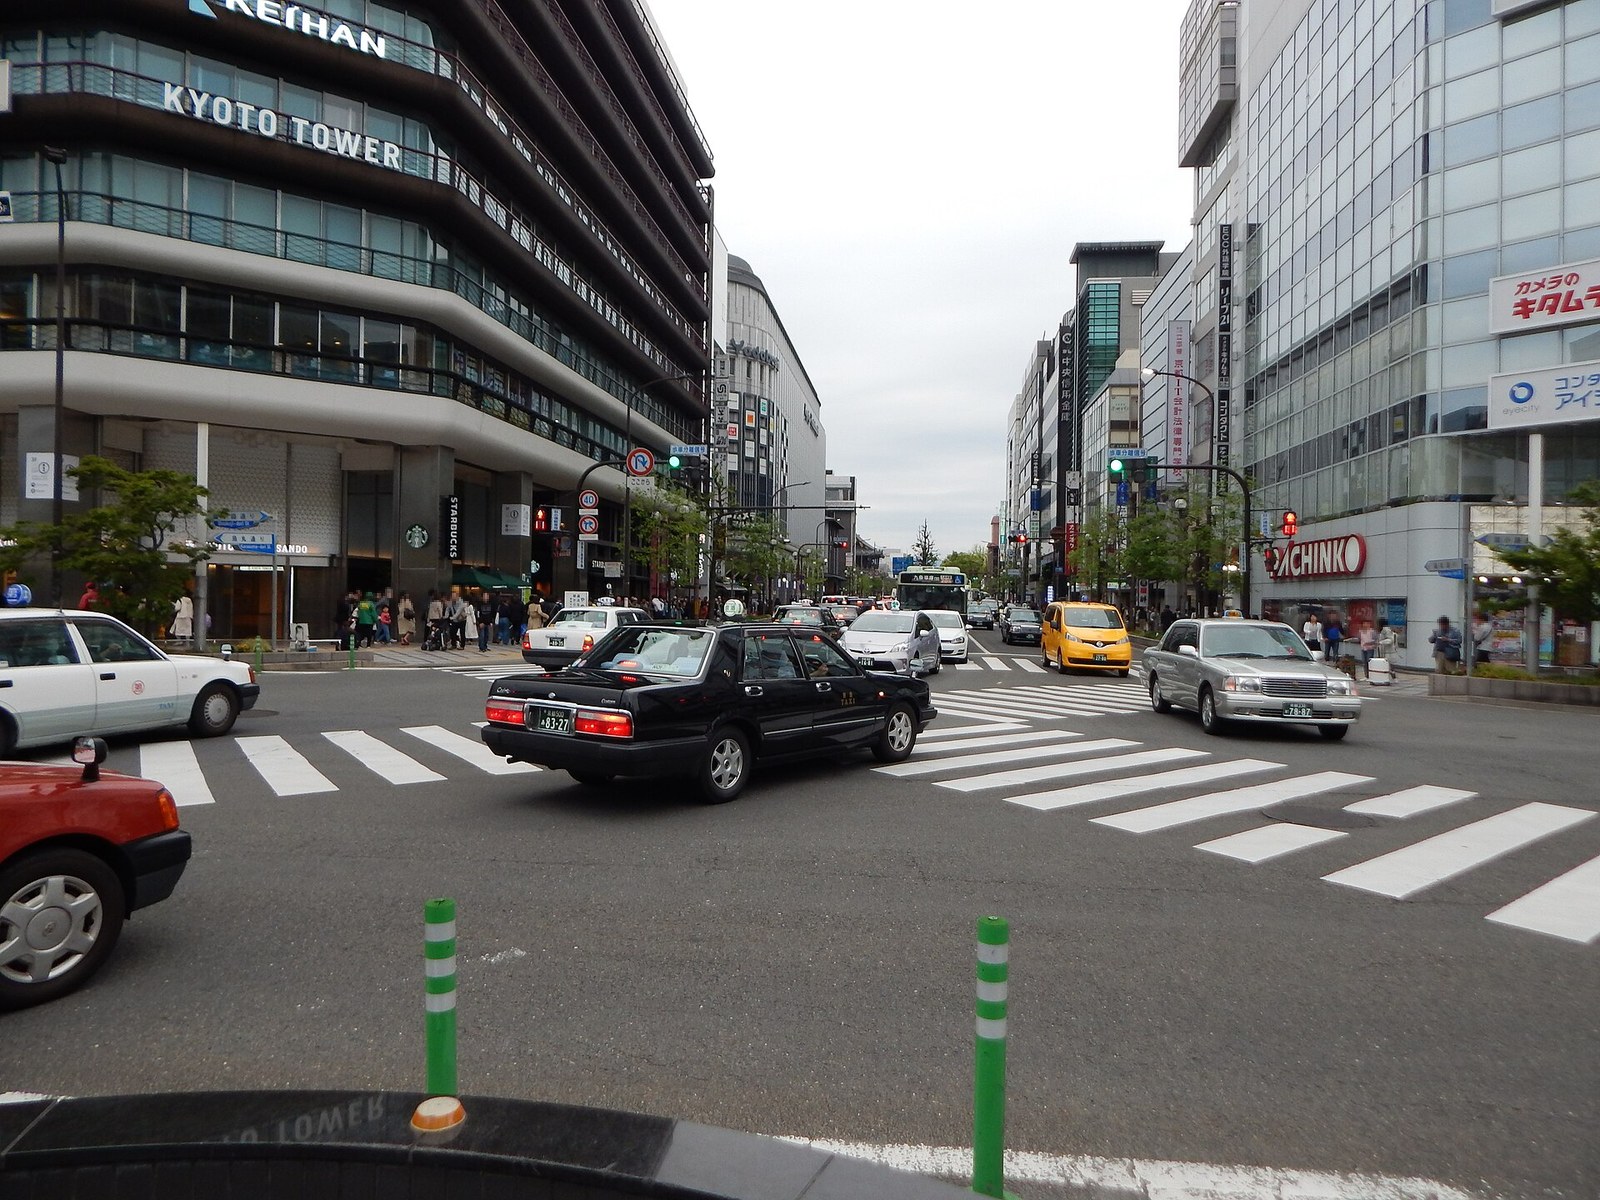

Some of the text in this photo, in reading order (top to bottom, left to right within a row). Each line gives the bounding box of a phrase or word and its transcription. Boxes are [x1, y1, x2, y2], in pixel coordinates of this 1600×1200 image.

[224, 0, 387, 58] KEIHAN
[163, 82, 402, 170] KYOTO TOWER
[1514, 272, 1580, 296] カメラの
[1219, 286, 1231, 326] リーブ21
[1502, 403, 1540, 417] eyecity
[583, 495, 594, 504] 40
[449, 496, 459, 558] STARBUCKS
[276, 544, 308, 554] SANDO
